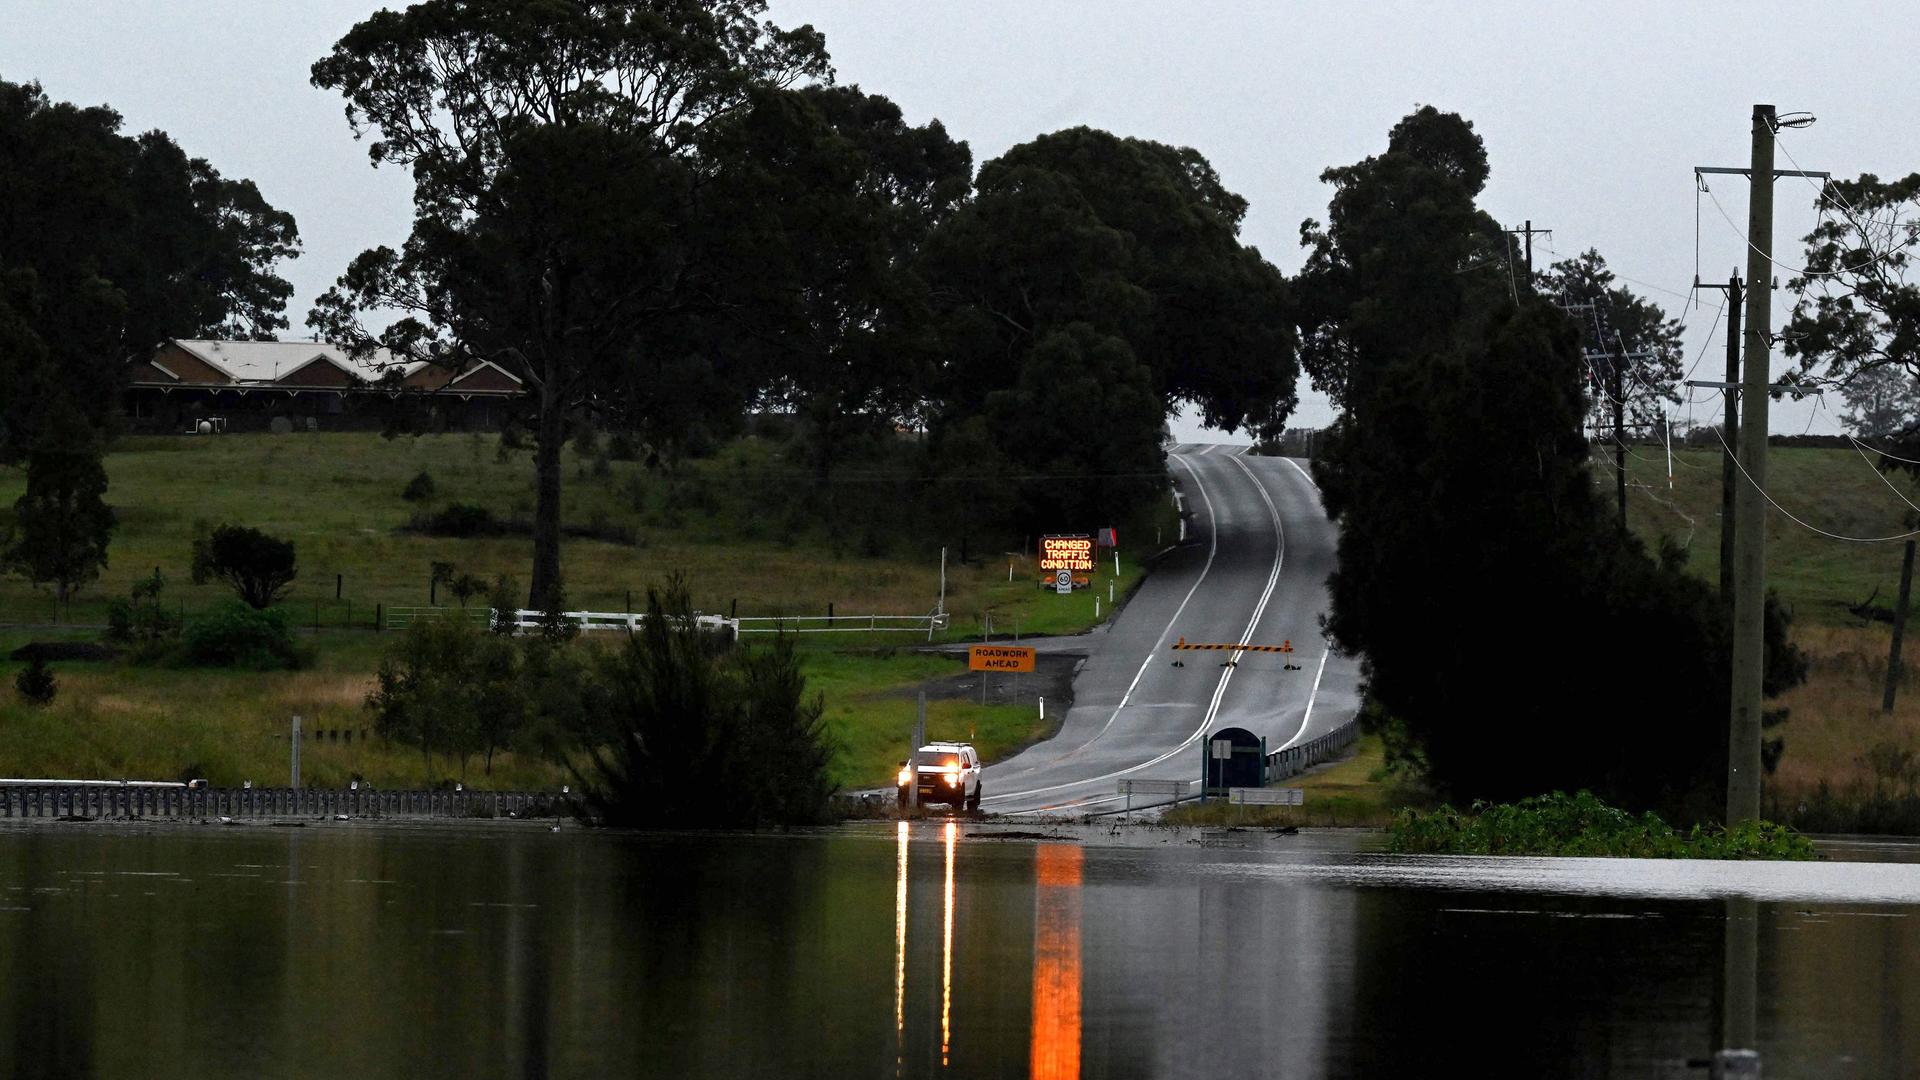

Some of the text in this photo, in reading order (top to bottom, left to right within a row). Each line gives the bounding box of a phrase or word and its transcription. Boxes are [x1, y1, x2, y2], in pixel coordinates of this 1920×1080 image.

[1044, 539, 1092, 550] CHANGED
[1045, 549, 1090, 560] TRAFFIC
[1041, 559, 1096, 570] CONDITION
[975, 648, 1029, 658] ROADWORK
[985, 659, 1019, 668] AHEAD
